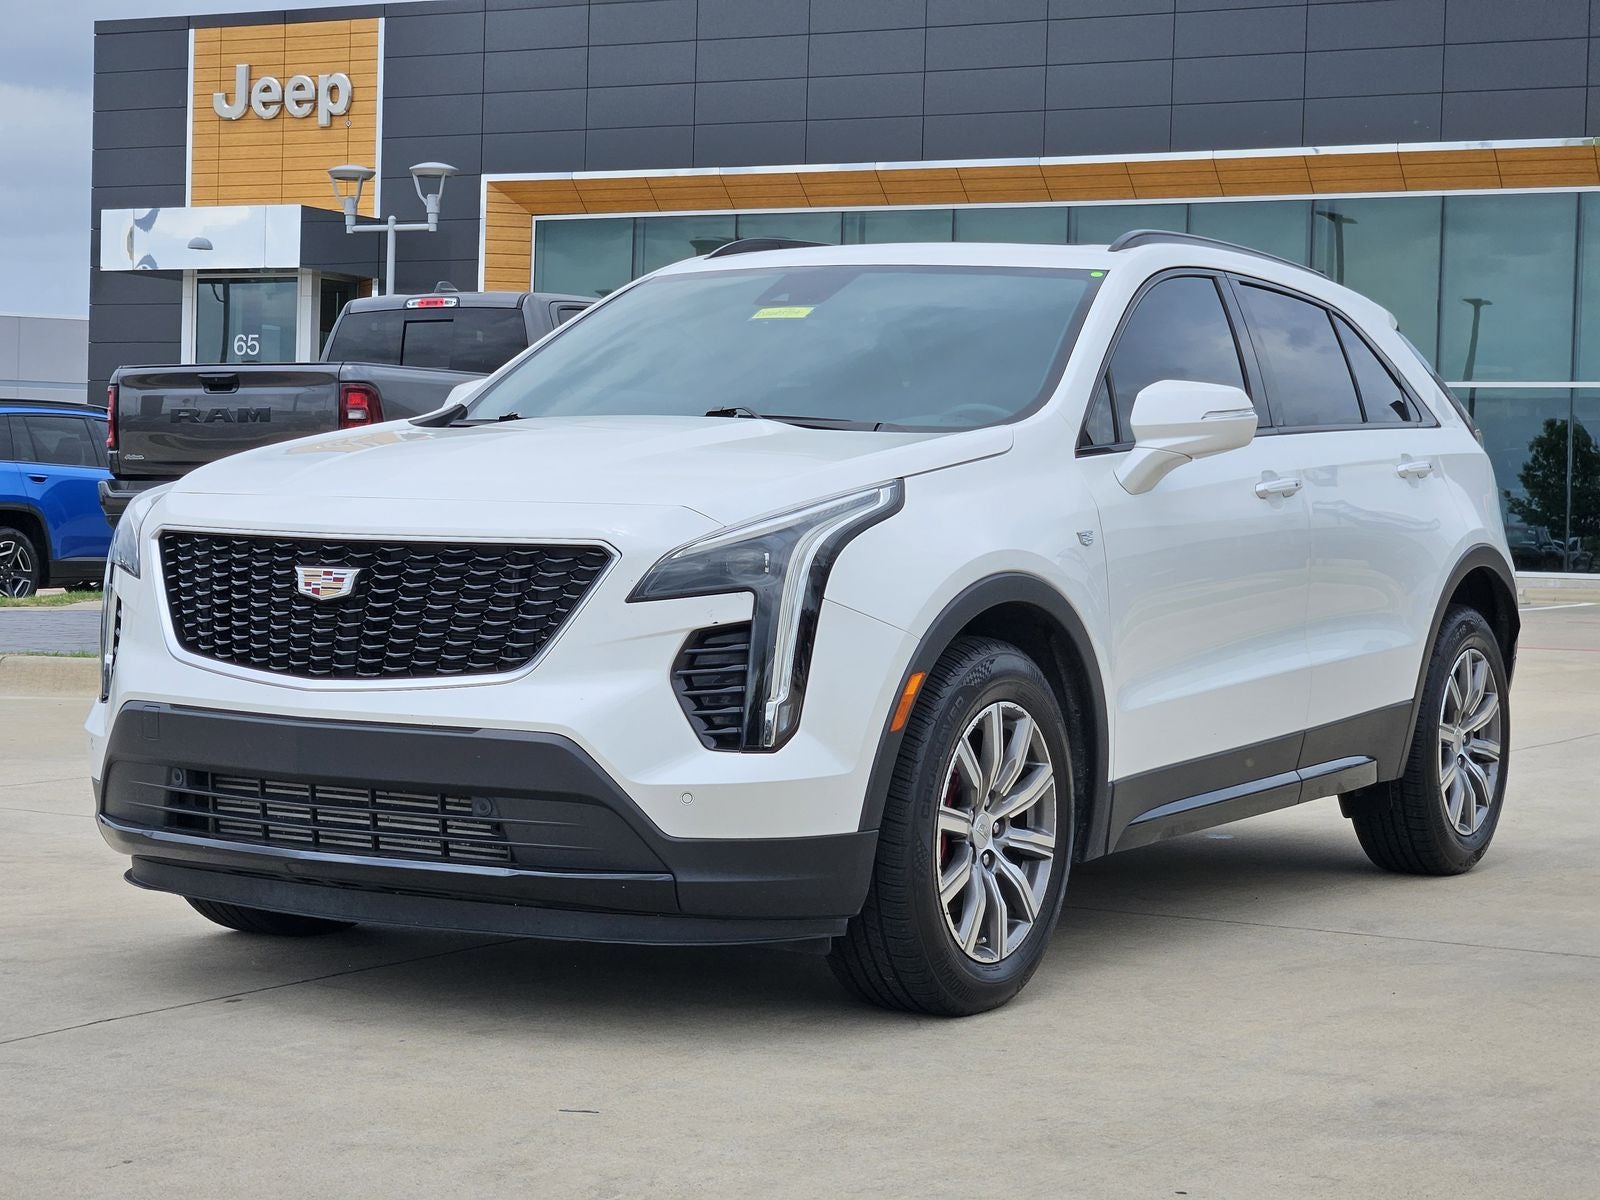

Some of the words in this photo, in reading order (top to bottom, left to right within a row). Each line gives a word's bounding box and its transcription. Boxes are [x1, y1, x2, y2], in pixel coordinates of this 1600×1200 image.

[213, 64, 352, 127] Jeep
[234, 334, 259, 355] 65
[170, 407, 271, 423] RAM
